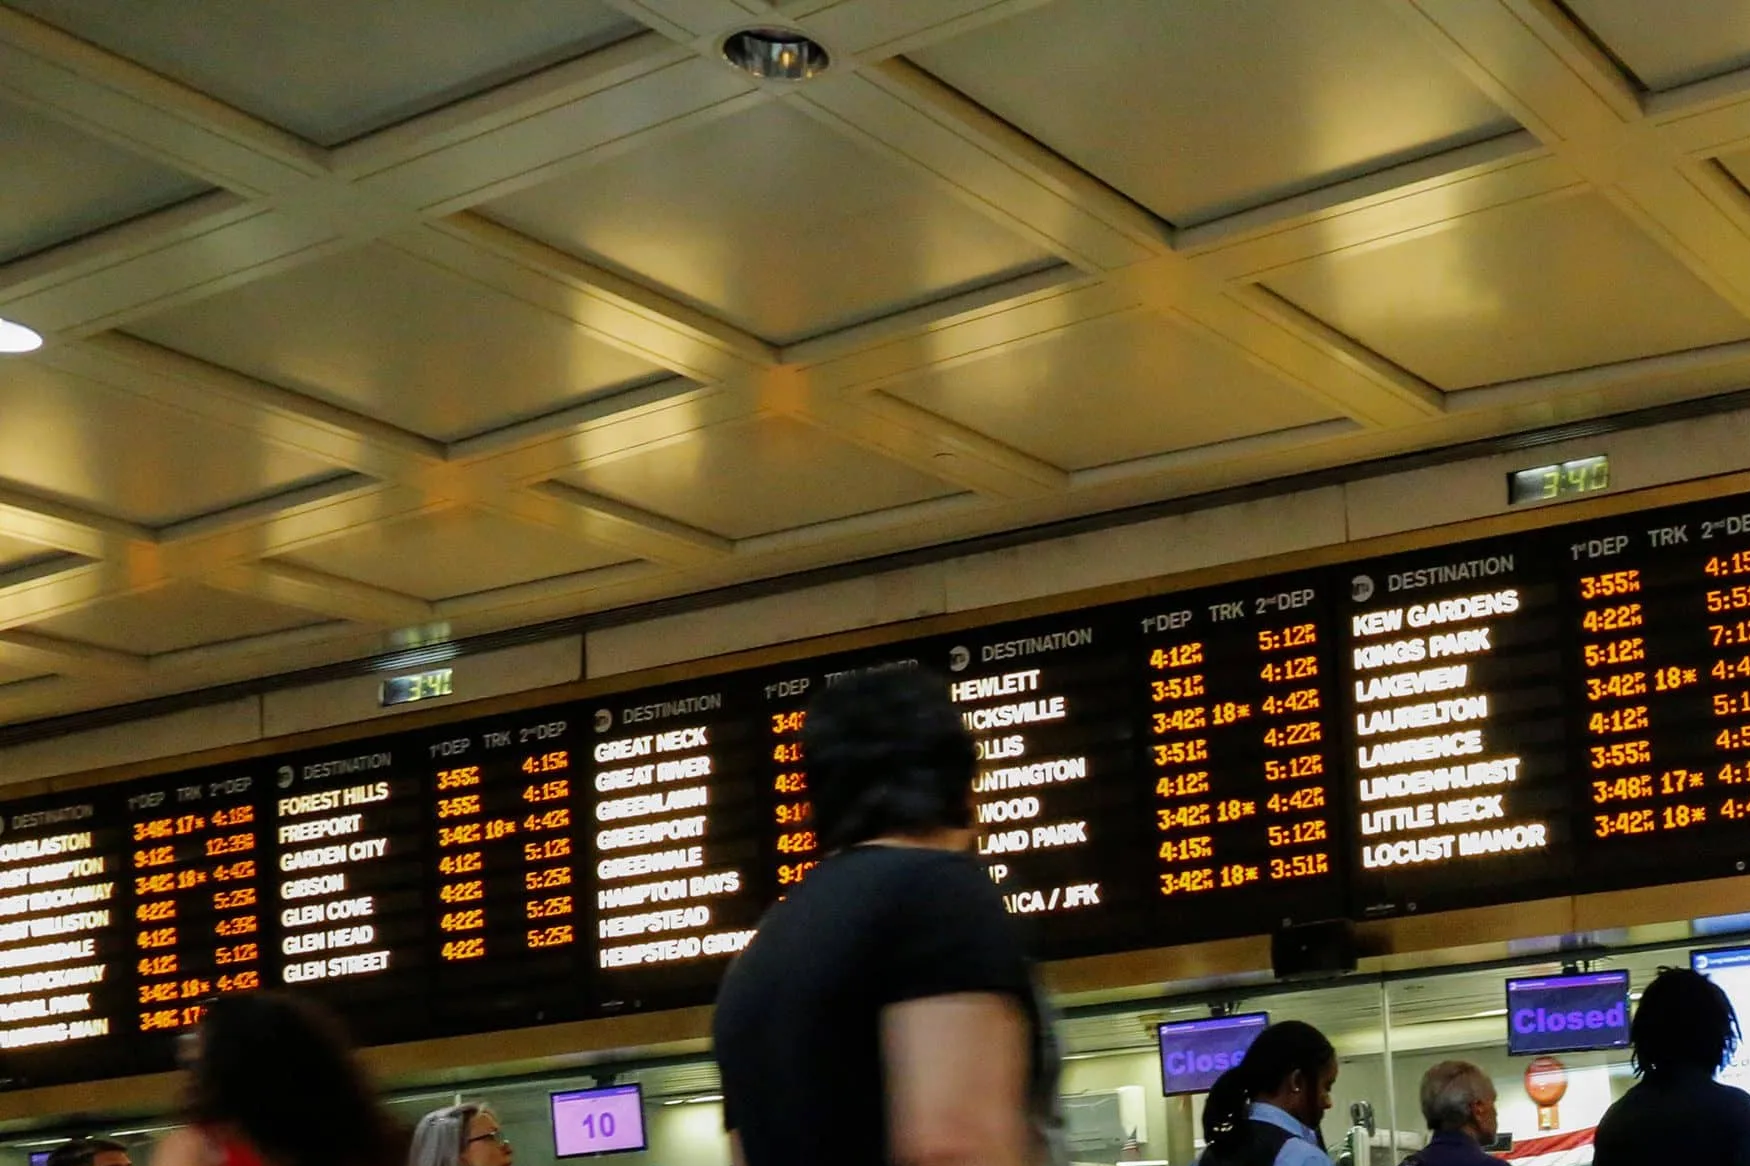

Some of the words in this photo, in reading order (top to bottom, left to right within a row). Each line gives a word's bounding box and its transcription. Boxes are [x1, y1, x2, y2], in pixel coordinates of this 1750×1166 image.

[1389, 555, 1513, 591] DESTINATION
[1648, 525, 1688, 546] TRK
[1353, 609, 1402, 636] KEW
[1407, 590, 1519, 627] GARDENS
[983, 629, 1091, 661] DESTINATION
[1209, 602, 1244, 621] TRK
[1354, 638, 1426, 670] KINGS
[1429, 628, 1491, 658] PARK
[952, 670, 1040, 701] HEWLETT
[1355, 664, 1467, 702] LAKEVIEW
[624, 695, 720, 723] DESTINATION
[1357, 695, 1488, 735] LAURELTON
[977, 735, 1024, 759] OLLIS
[304, 754, 390, 779] DESTINATION
[972, 757, 1085, 792] UNTINGTON
[976, 797, 1039, 823] WOOD
[1361, 804, 1434, 835] LITTLE
[1437, 794, 1504, 824] NECK
[978, 830, 1029, 854] LAND
[1032, 821, 1086, 848] PARK
[1363, 835, 1455, 868] LOCUST
[1459, 824, 1546, 856] MANOR
[1063, 883, 1099, 908] JFK
[1513, 1001, 1625, 1034] Closed
[1166, 1050, 1246, 1076] Close
[582, 1112, 615, 1139] 10
